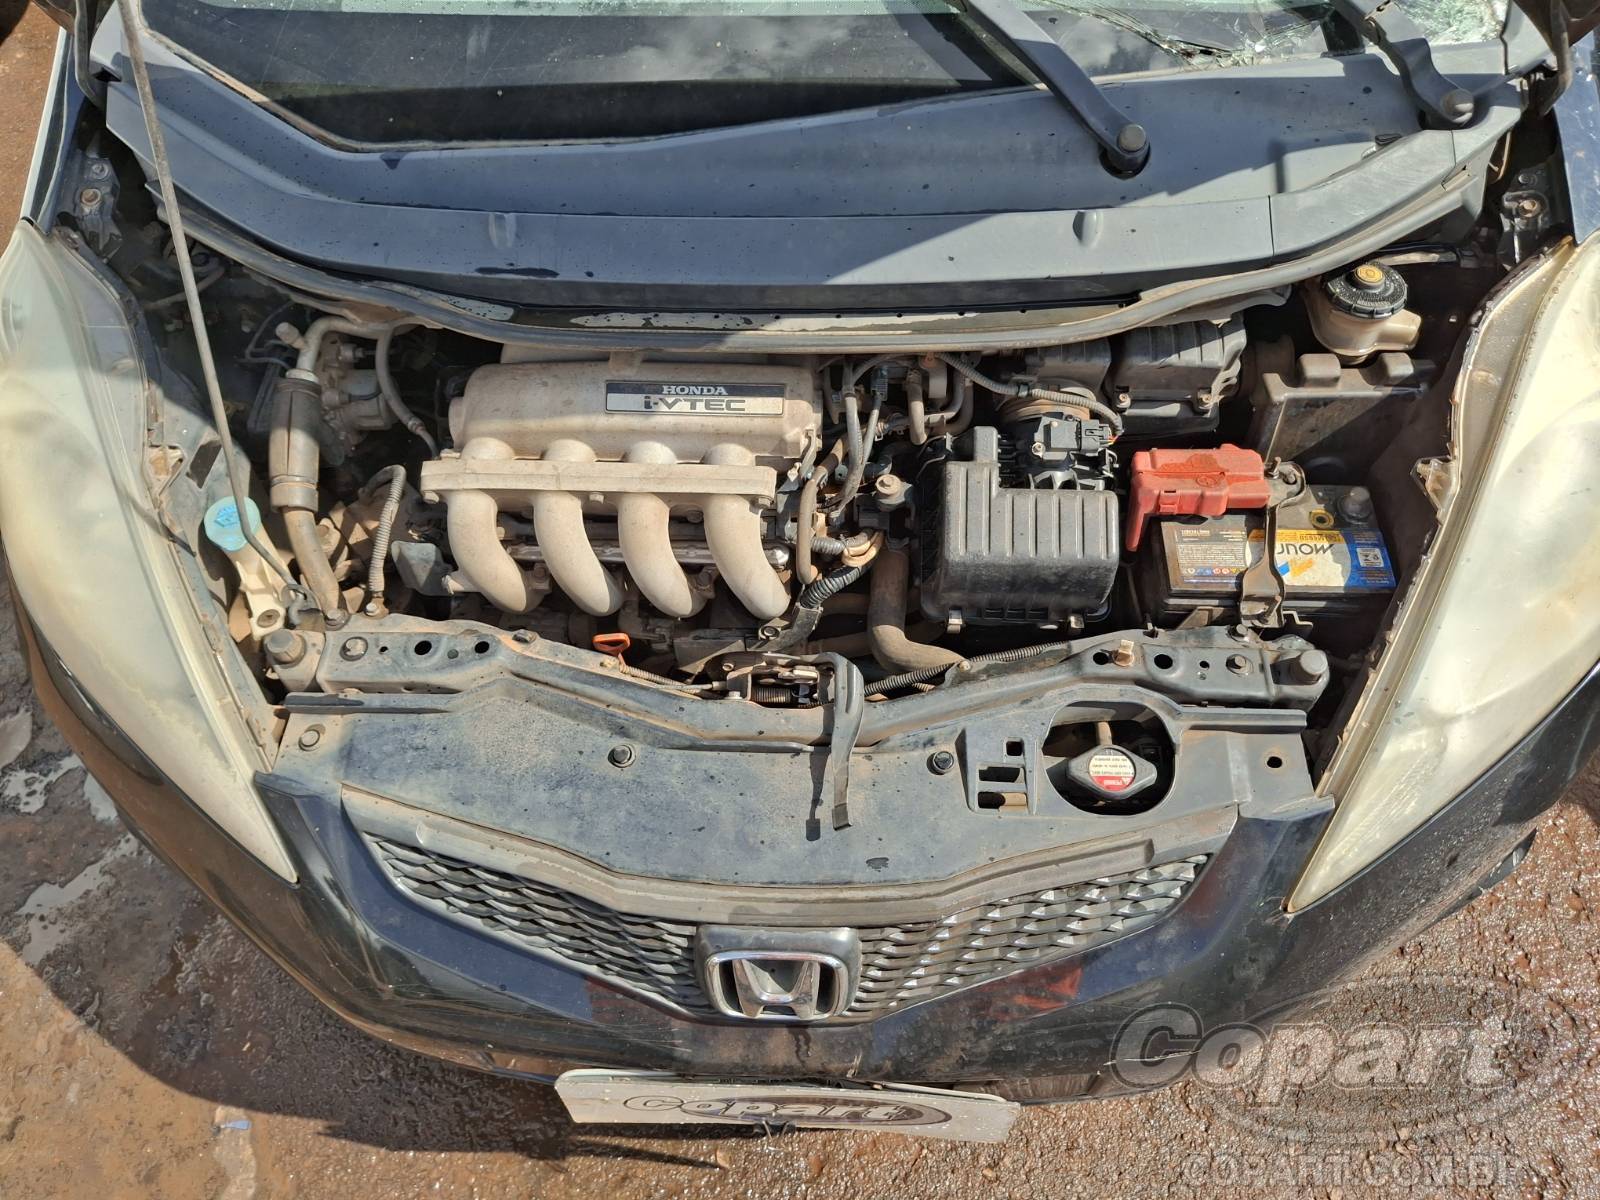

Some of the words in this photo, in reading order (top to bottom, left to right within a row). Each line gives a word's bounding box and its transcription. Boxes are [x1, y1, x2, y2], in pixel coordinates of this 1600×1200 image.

[662, 385, 728, 395] HONDA
[644, 396, 746, 411] i-VTEC
[623, 1095, 908, 1121] Copart
